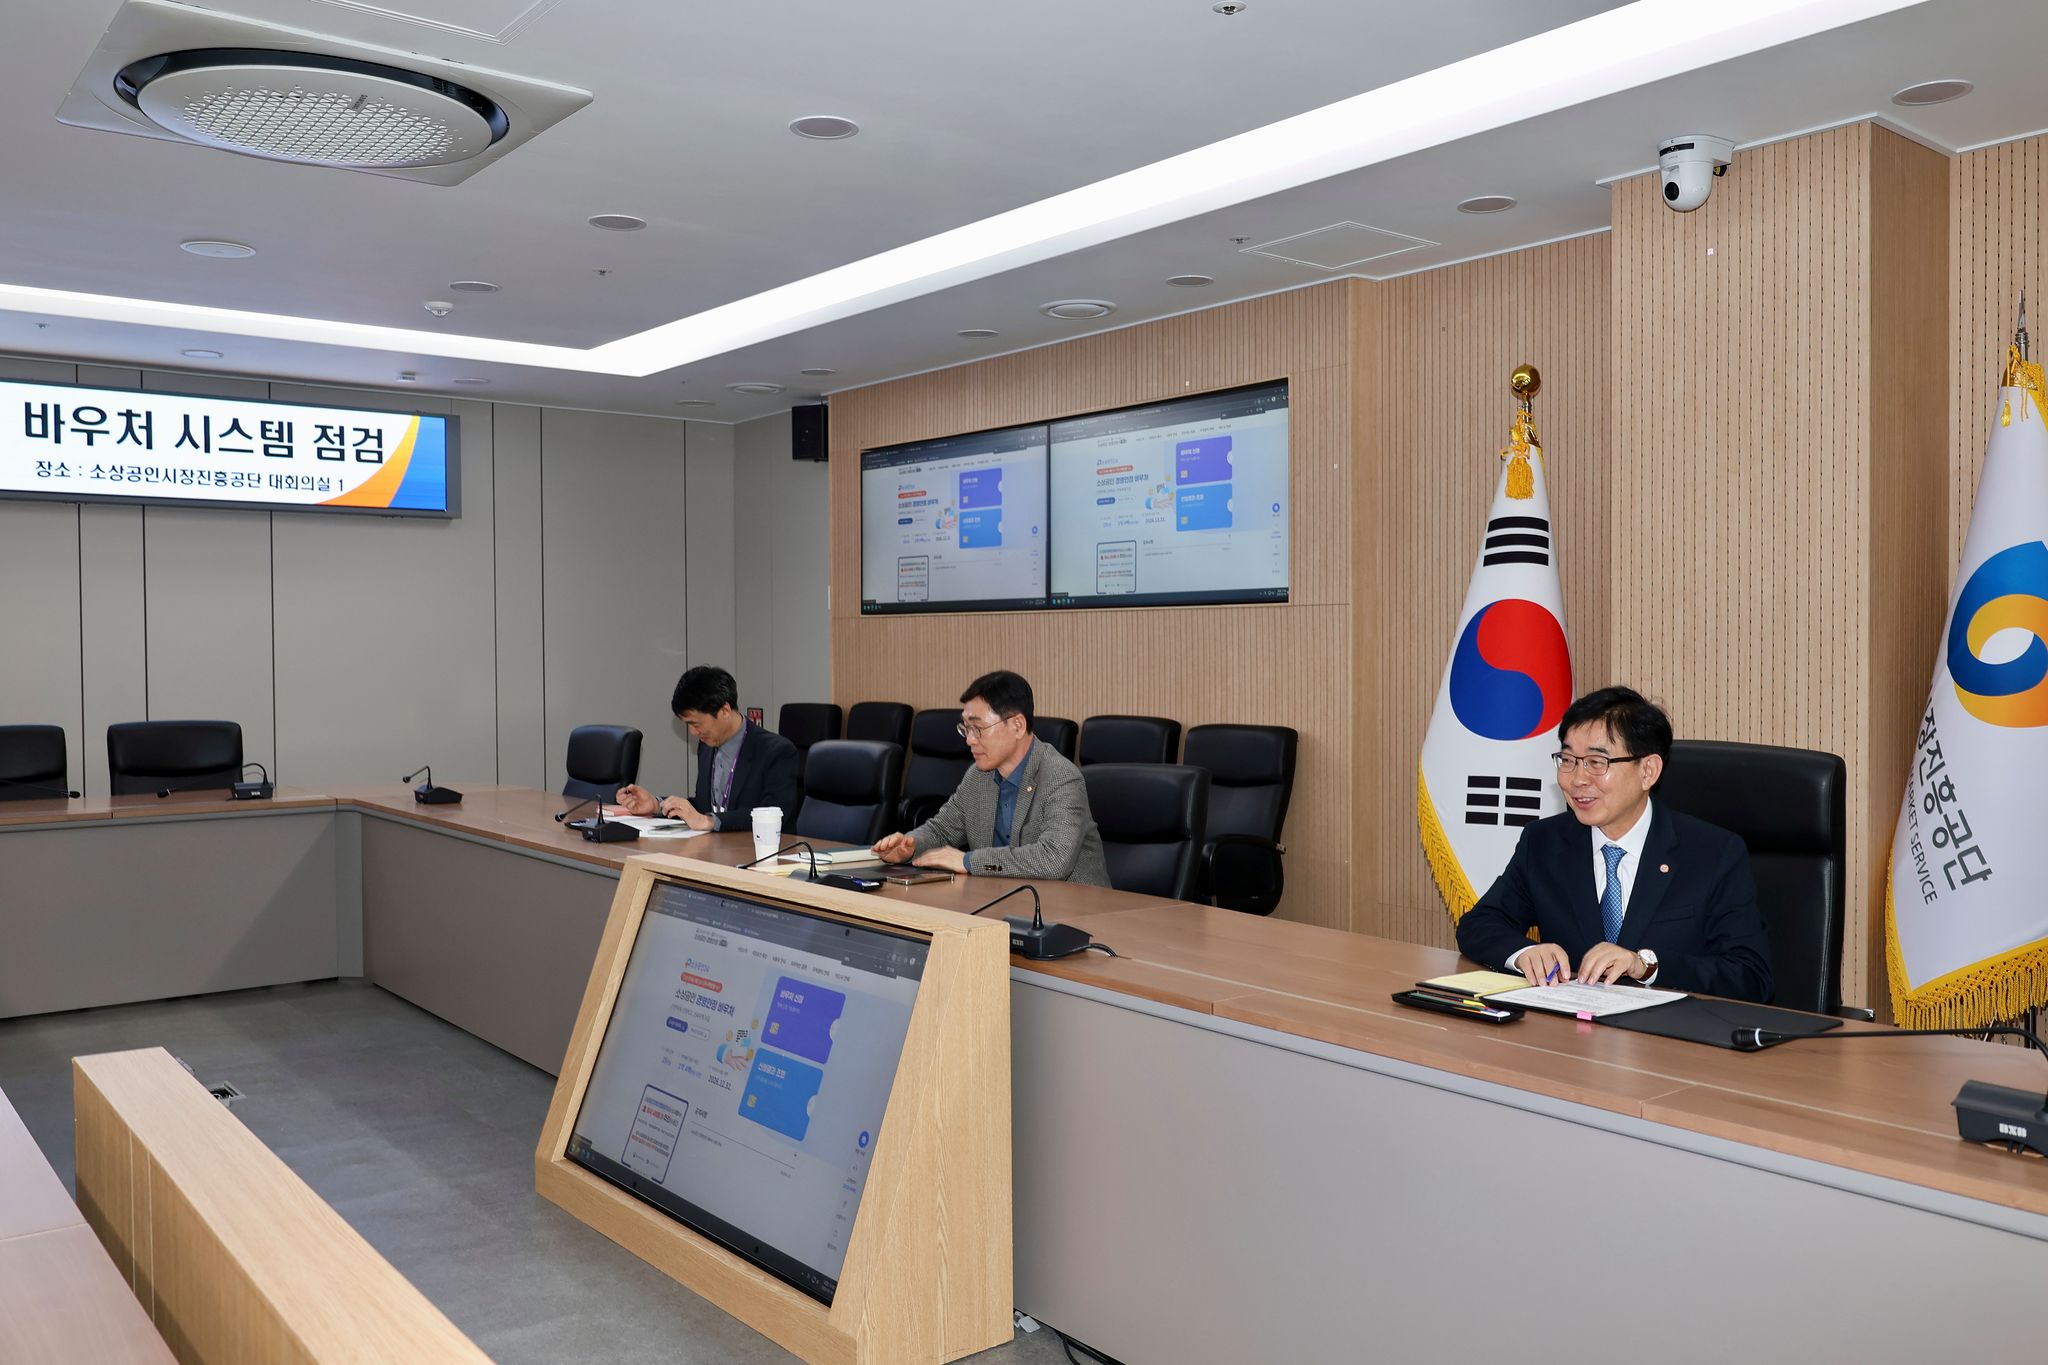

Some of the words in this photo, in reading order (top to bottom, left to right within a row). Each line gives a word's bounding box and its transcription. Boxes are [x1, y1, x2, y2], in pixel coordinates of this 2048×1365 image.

[24, 401, 154, 451] 바우처
[174, 413, 294, 459] 시스템
[313, 424, 385, 465] 점검
[35, 460, 71, 478] 장소
[90, 463, 262, 488] 소상공인시장진흥공단
[269, 473, 331, 492] 대회의실
[1918, 697, 1993, 891] 장진흥공단
[1910, 833, 1938, 905] SERVICE
